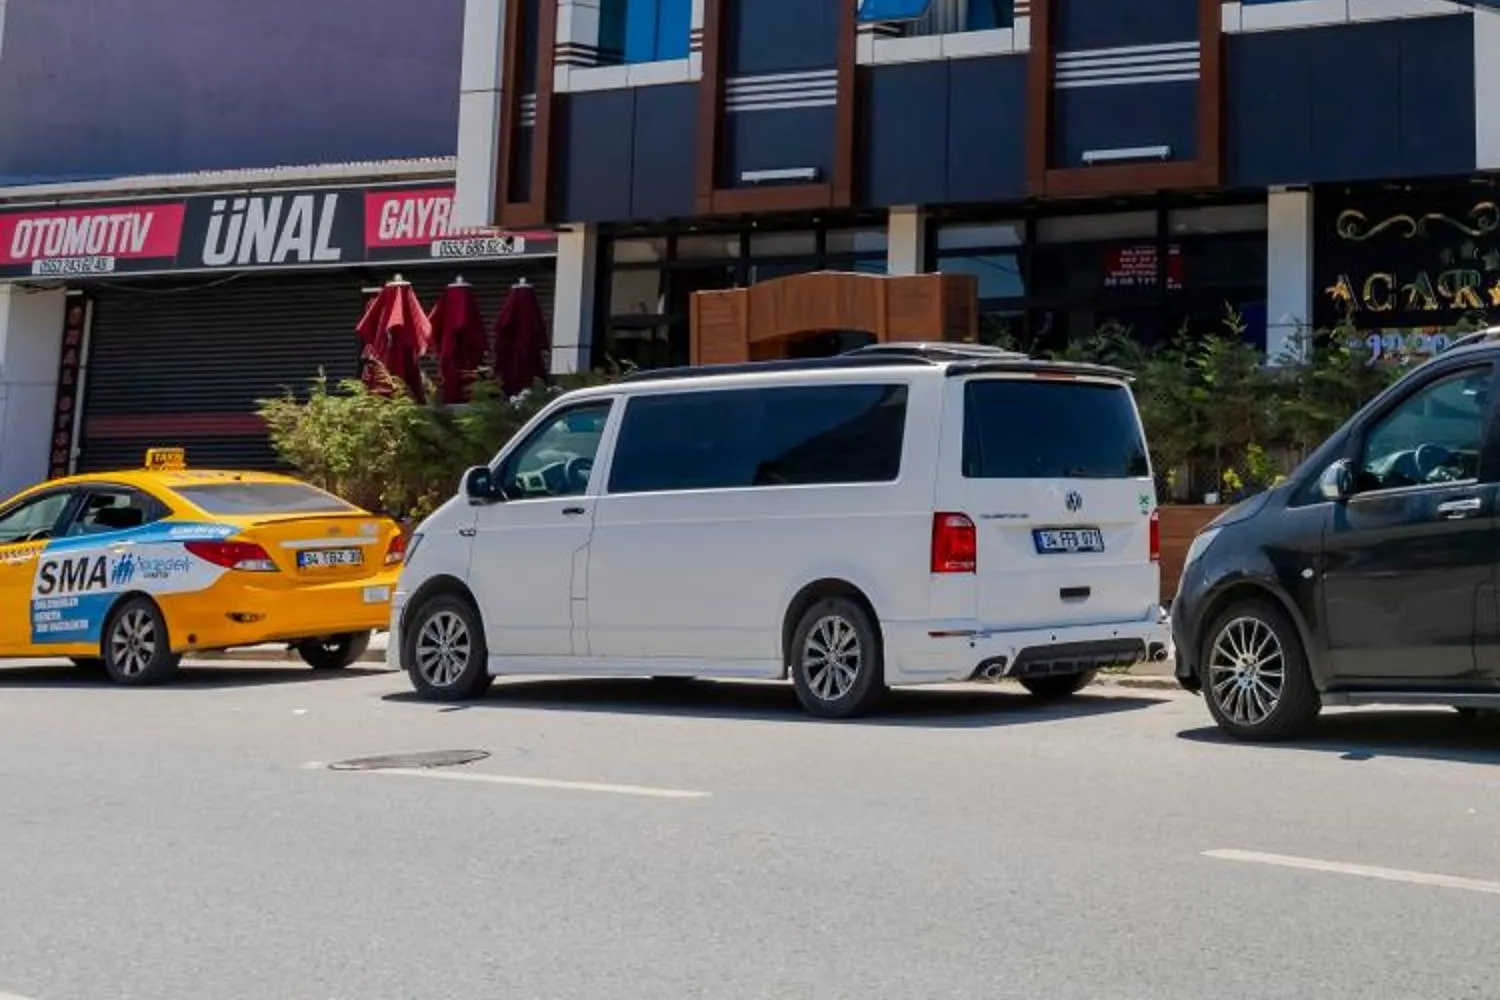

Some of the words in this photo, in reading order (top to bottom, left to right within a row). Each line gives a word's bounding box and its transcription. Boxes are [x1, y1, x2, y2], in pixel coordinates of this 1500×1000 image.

[10, 212, 154, 259] OTOMOTİV
[202, 193, 341, 266] ÜNAL
[307, 553, 320, 565] 34
[1043, 533, 1057, 547] 34
[37, 556, 108, 595] SMA
